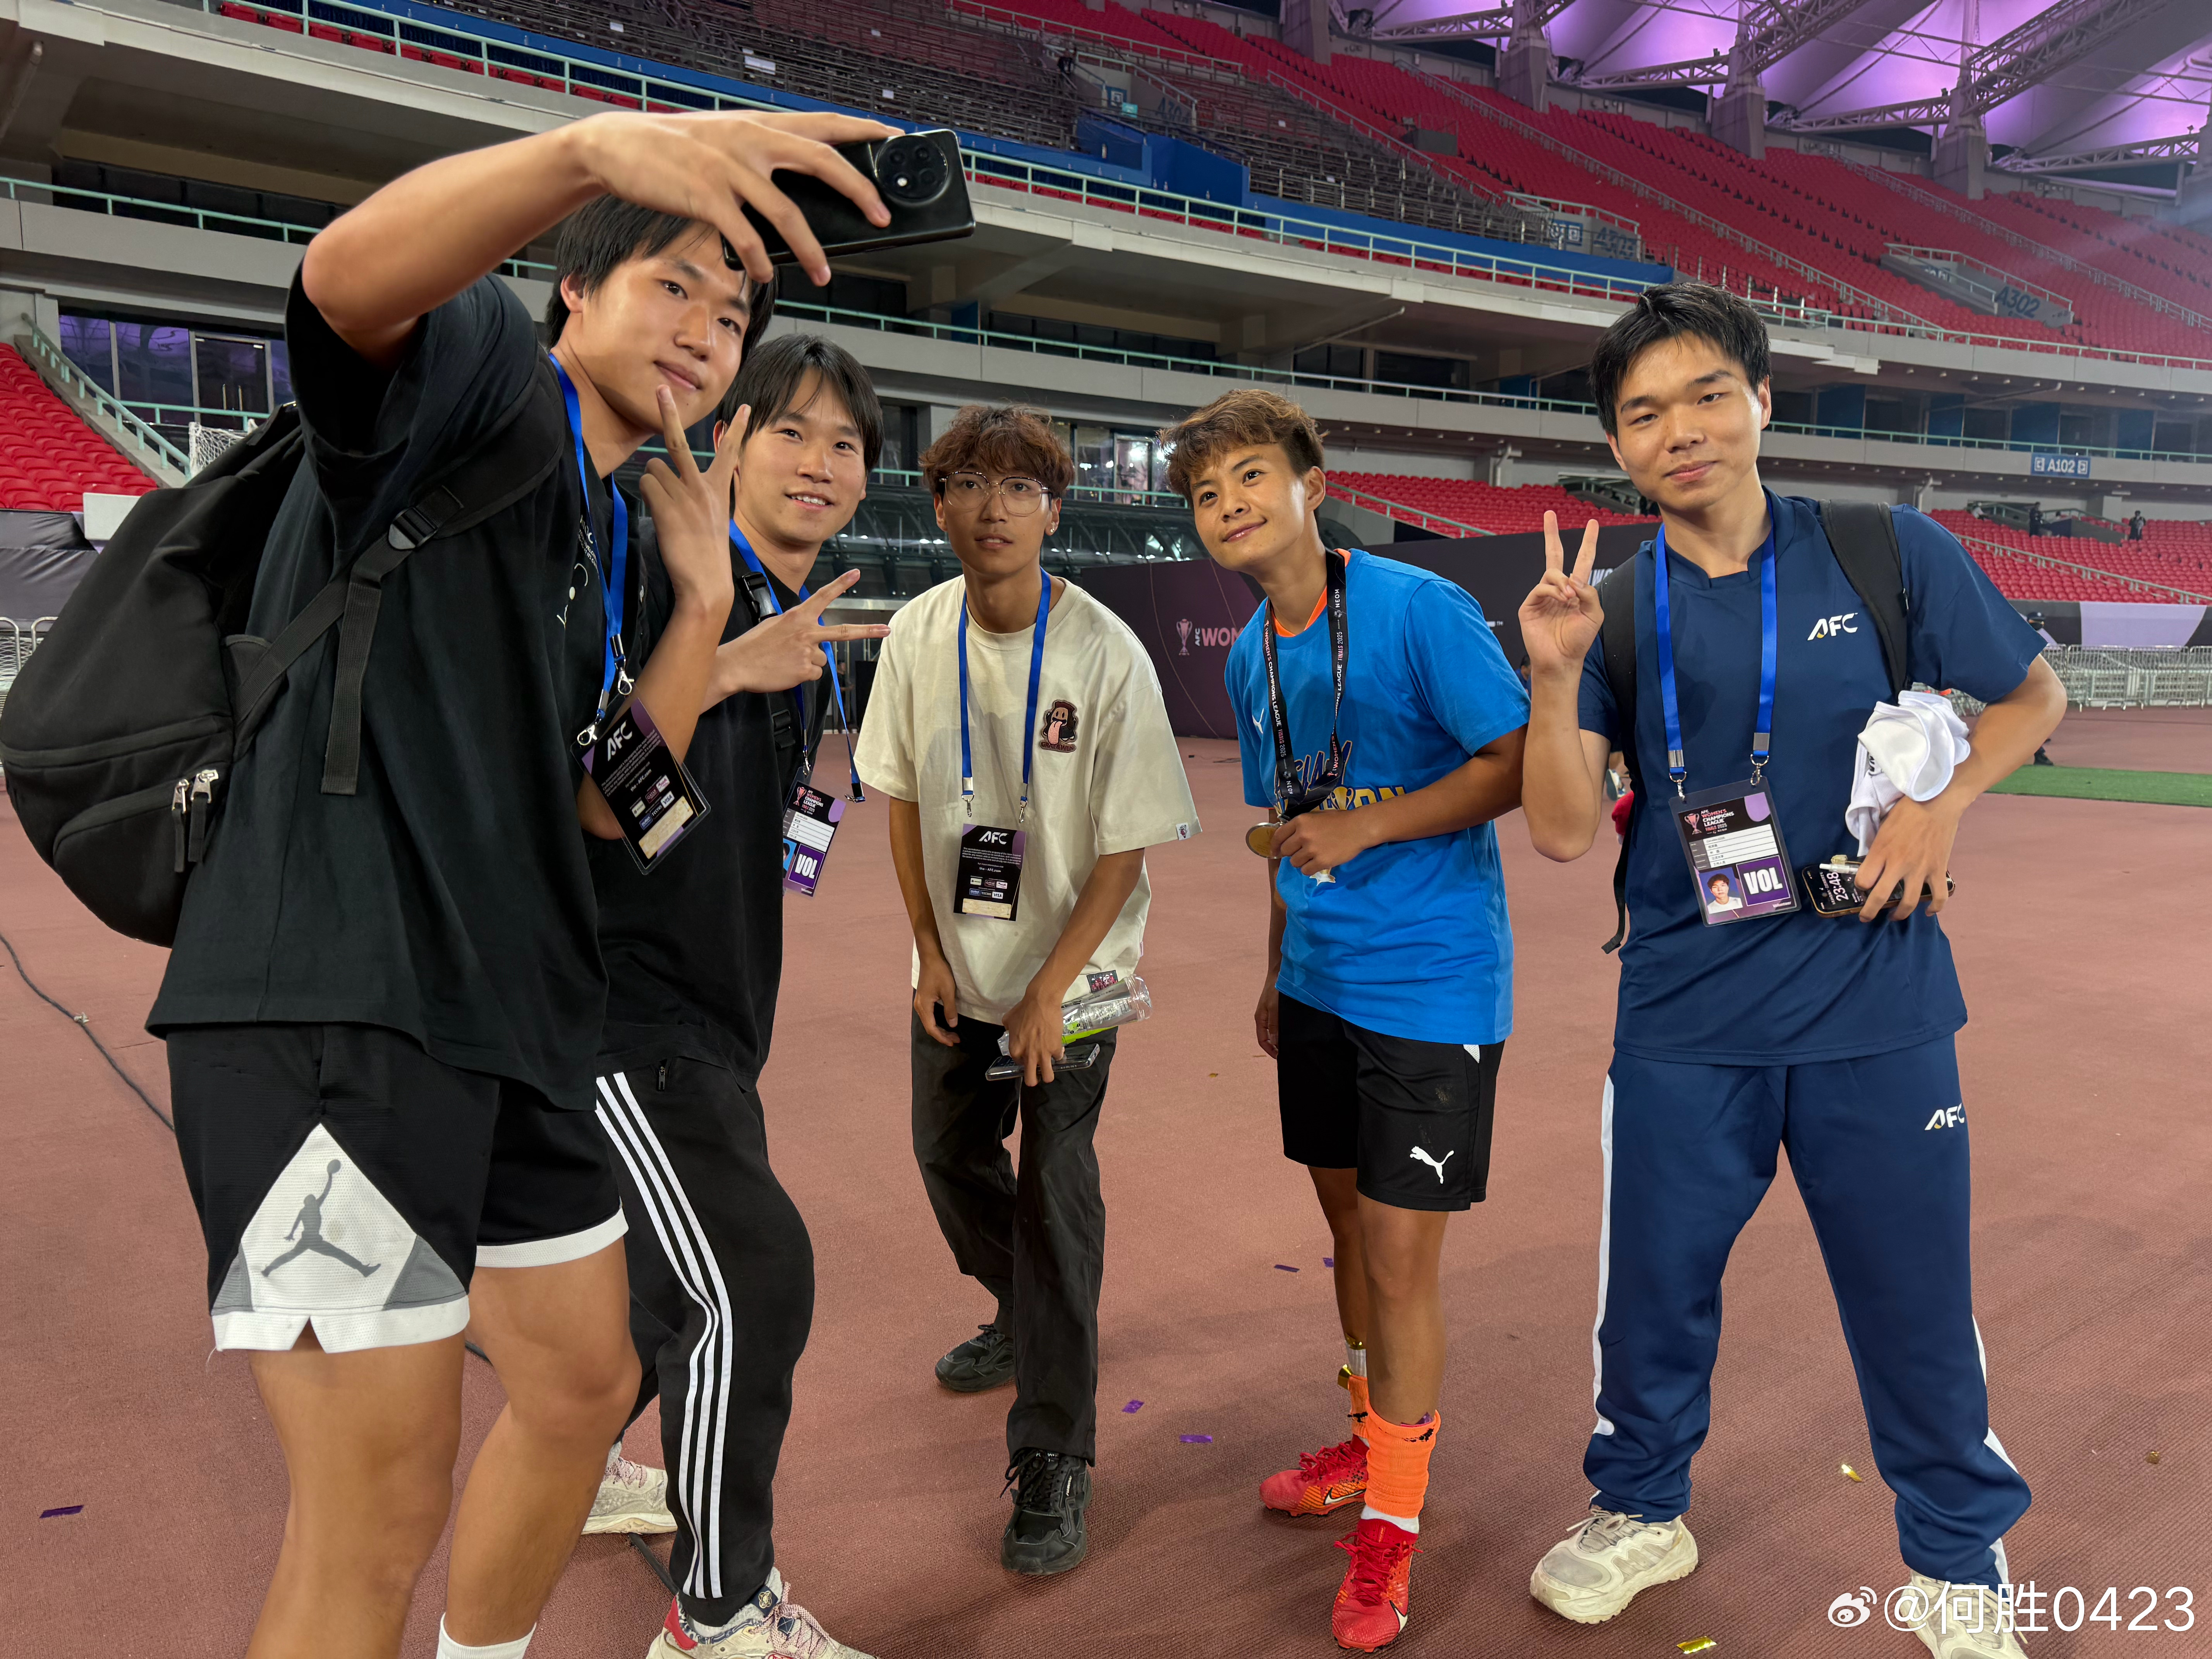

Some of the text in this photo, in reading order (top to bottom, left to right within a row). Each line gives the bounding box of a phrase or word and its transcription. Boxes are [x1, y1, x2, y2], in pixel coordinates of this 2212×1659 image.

[1995, 286, 2040, 318] A302
[2047, 459, 2076, 473] A102
[1807, 613, 1858, 641] AFC
[1268, 661, 1276, 701] CHAMPIONS
[1272, 701, 1280, 726] LEAGUE
[607, 720, 633, 762] AFC
[663, 794, 673, 804] VISA
[1701, 809, 1727, 818] WOMEN'S
[1703, 811, 1735, 823] CHAMPIONS
[1704, 818, 1725, 827] LEAGUE
[979, 831, 1008, 845] AFC
[795, 854, 818, 879] VOL
[1743, 867, 1783, 895] VOL
[1827, 872, 1849, 902] 23:48
[1924, 1103, 1965, 1131] AFC
